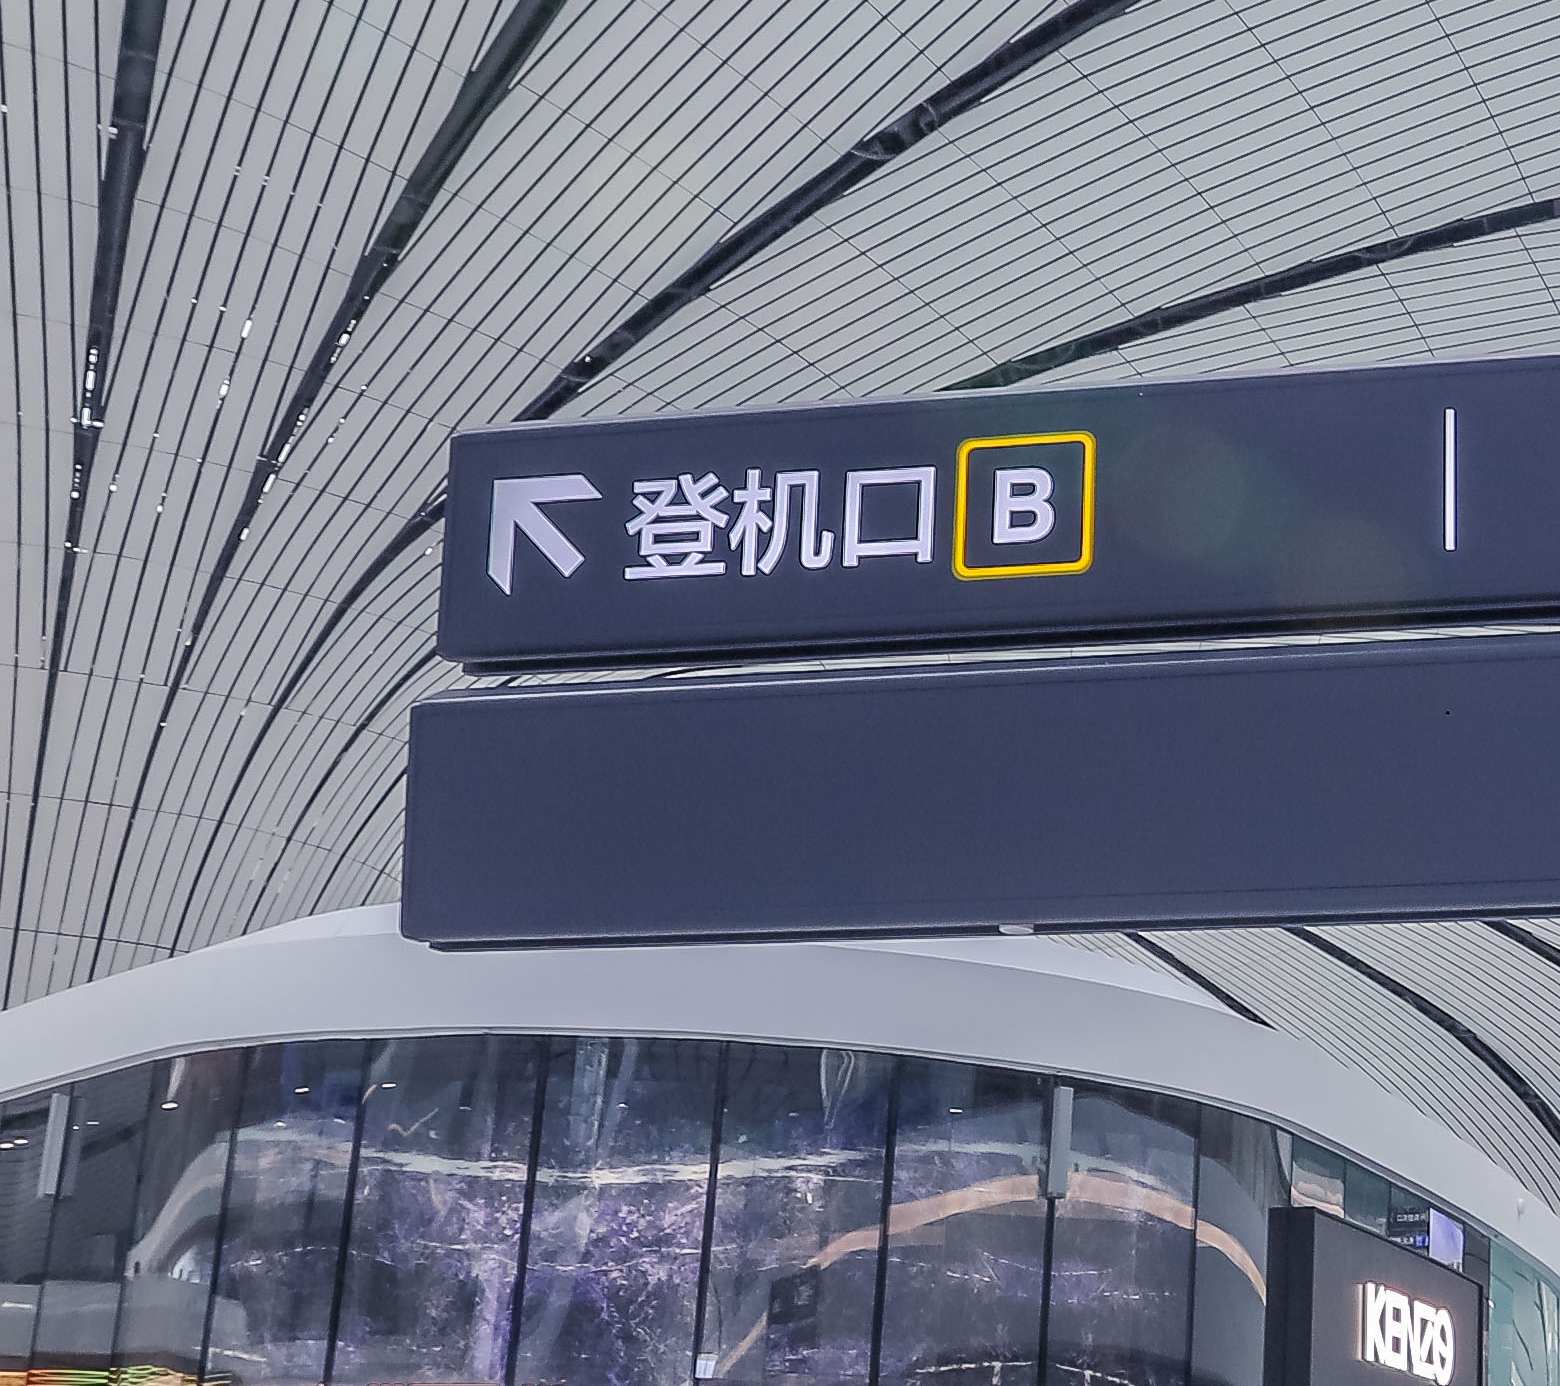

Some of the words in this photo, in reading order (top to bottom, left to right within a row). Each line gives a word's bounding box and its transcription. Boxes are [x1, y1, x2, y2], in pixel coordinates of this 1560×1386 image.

[622, 464, 938, 582] 登机口
[991, 467, 1056, 545] B
[1360, 1280, 1455, 1386] KENZO
